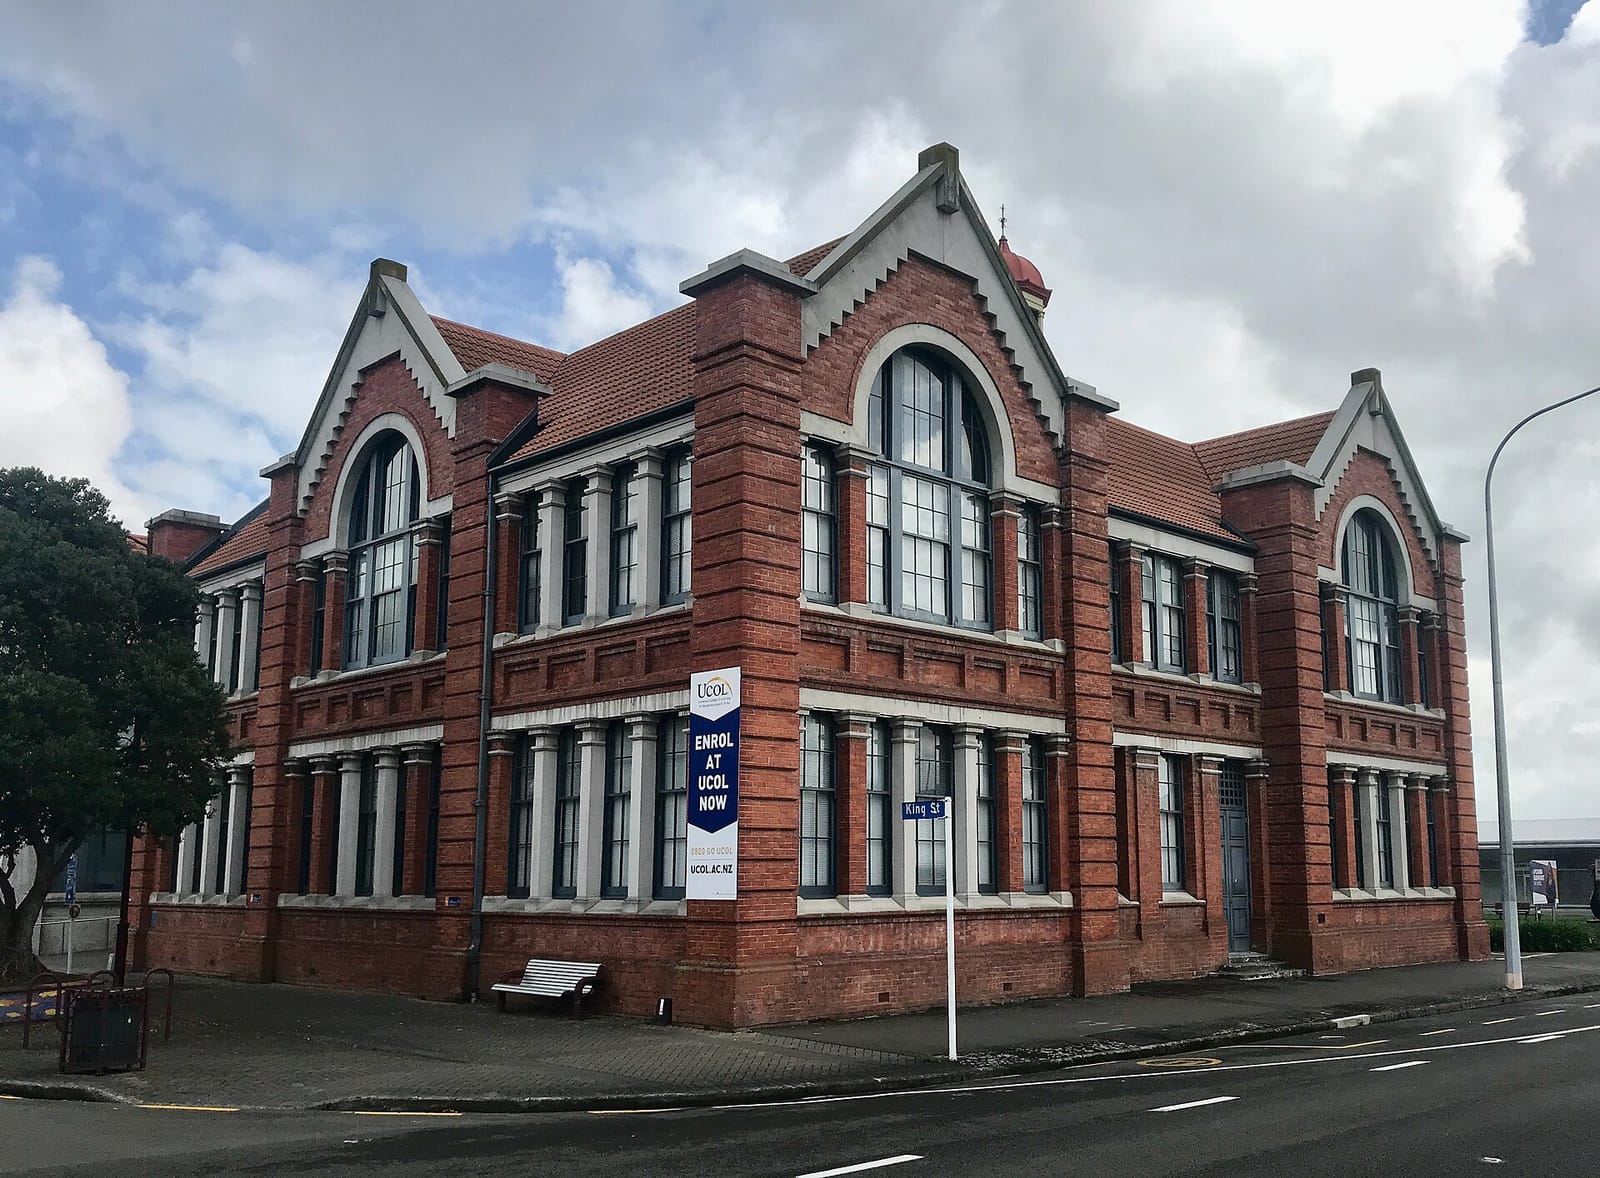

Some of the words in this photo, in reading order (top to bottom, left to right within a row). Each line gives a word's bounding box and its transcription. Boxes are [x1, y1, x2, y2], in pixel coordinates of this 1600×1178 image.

[695, 732, 734, 750] ENROL
[705, 754, 721, 770] AT
[698, 774, 728, 790] UCOL
[699, 795, 727, 811] NOW
[905, 803, 926, 817] King
[930, 802, 940, 814] St
[716, 847, 733, 855] UCOL
[690, 864, 733, 874] UCOL.AC.NZ
